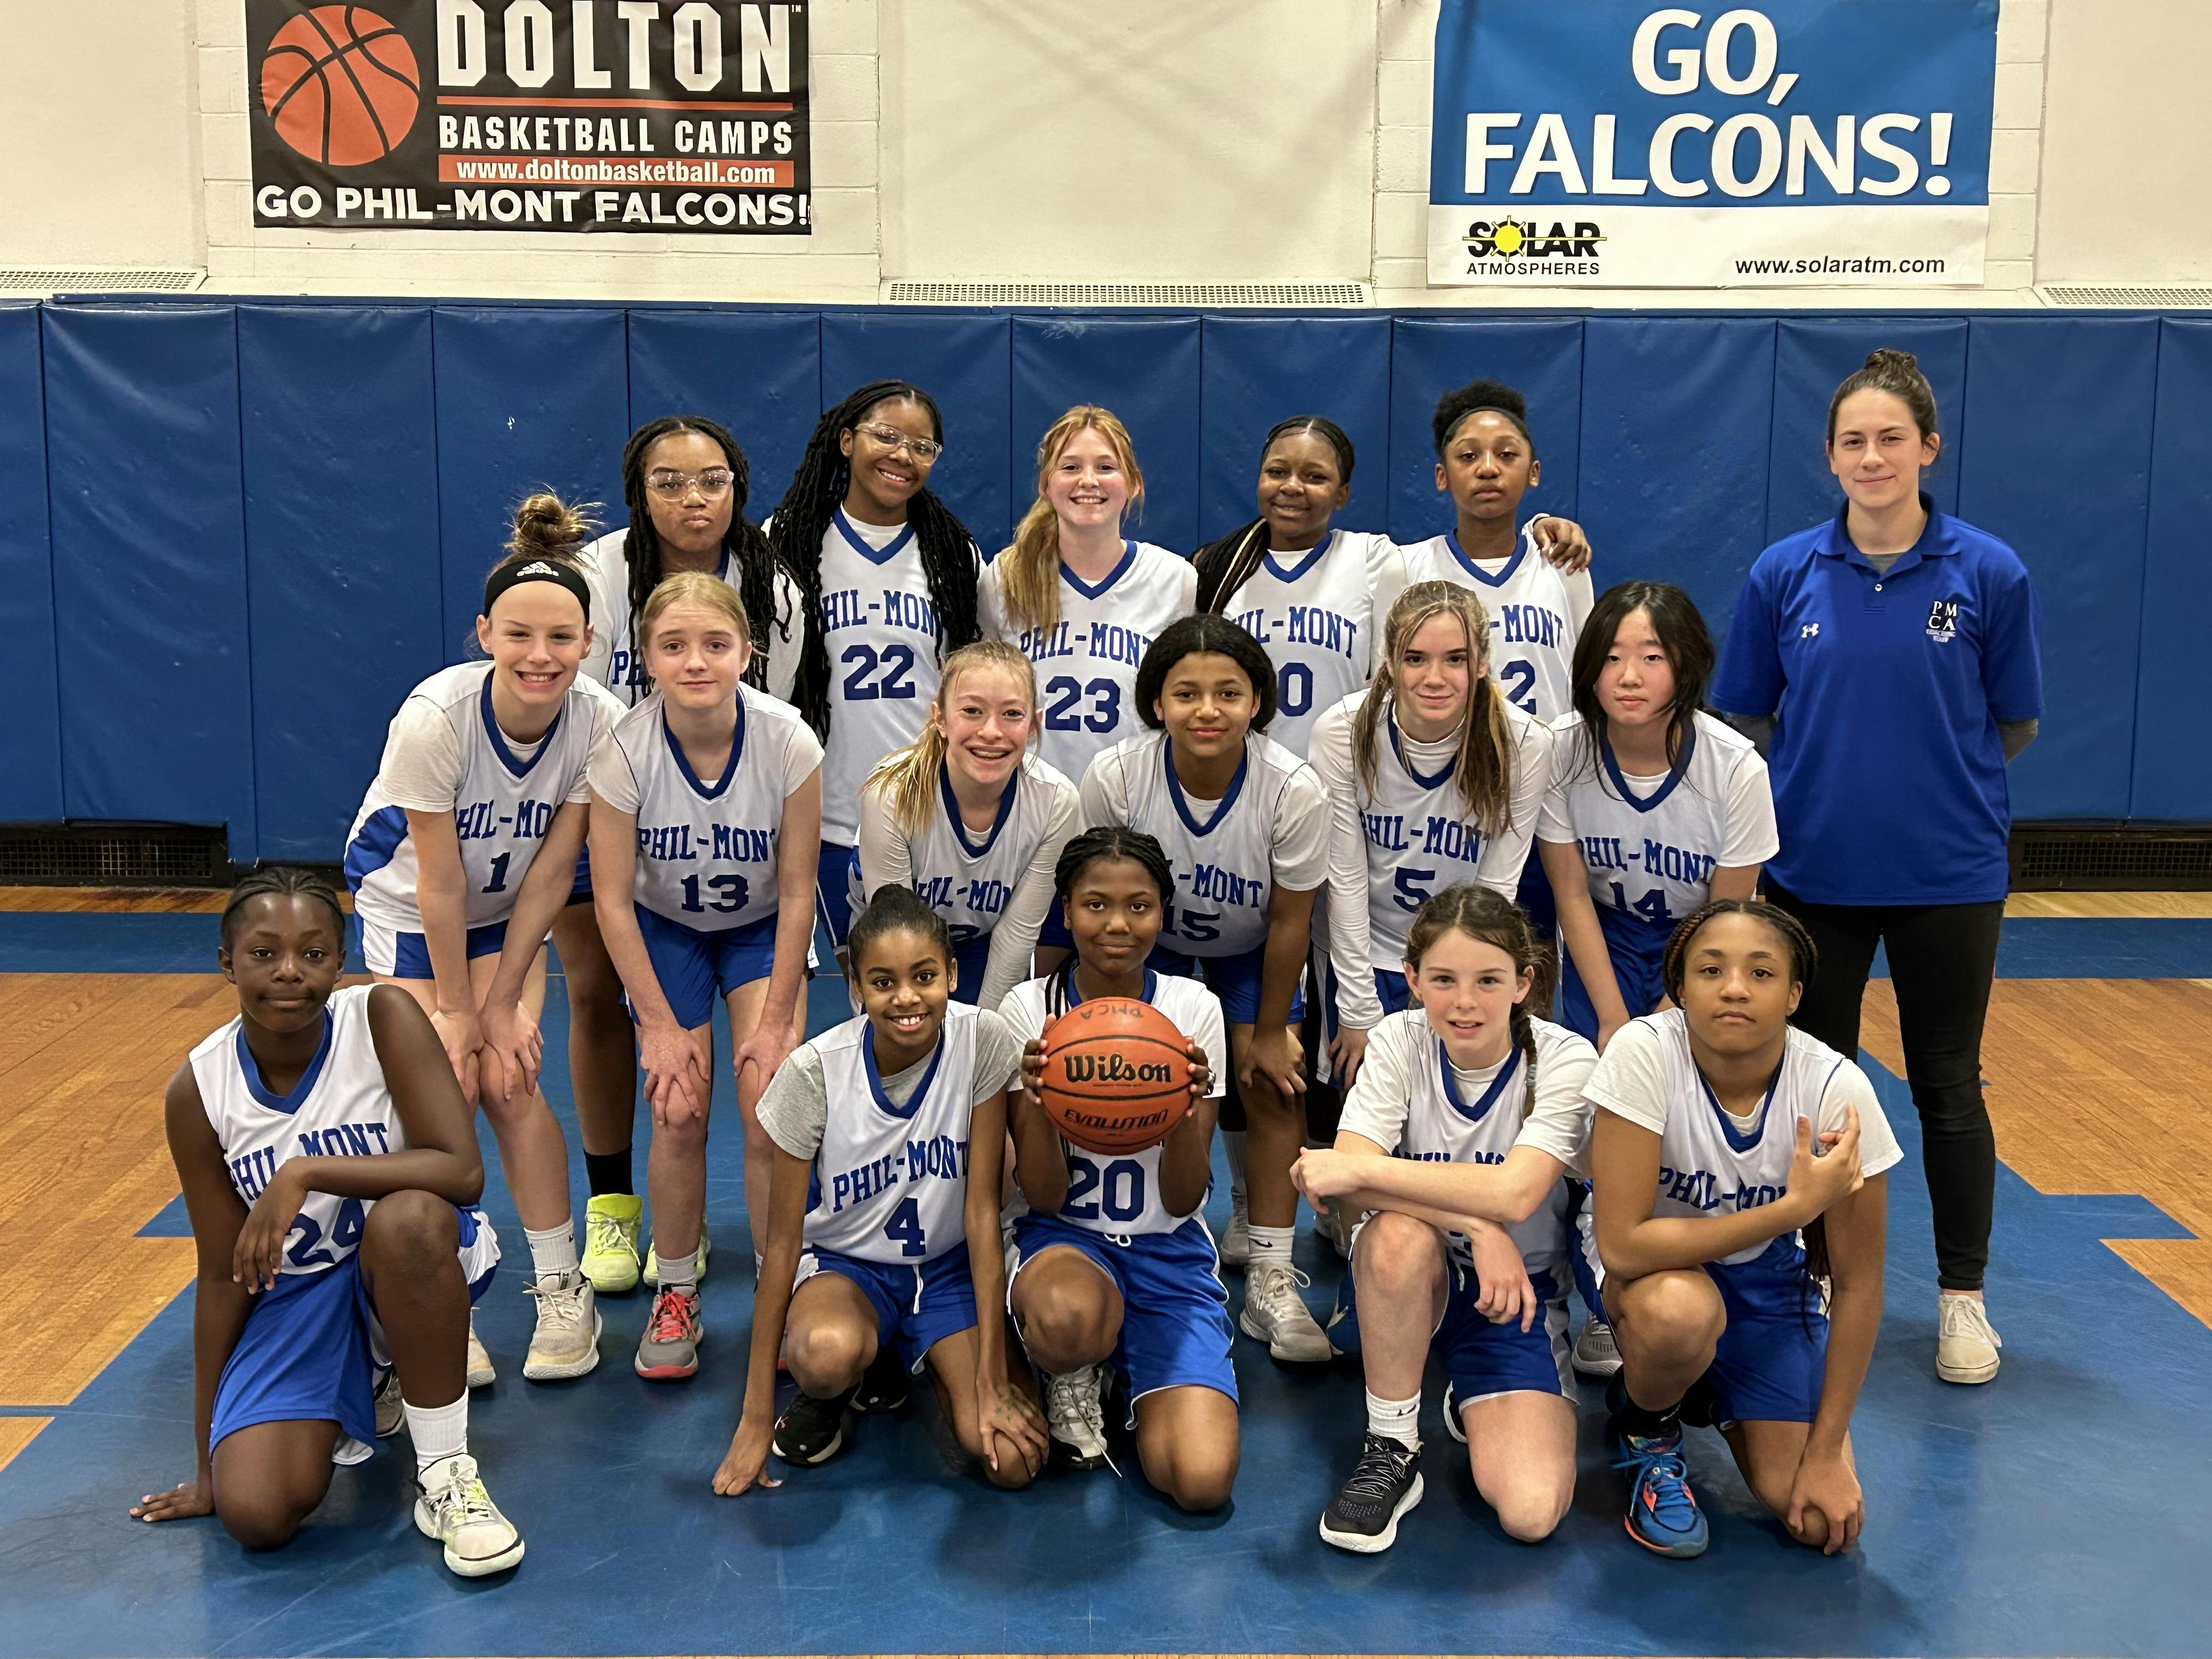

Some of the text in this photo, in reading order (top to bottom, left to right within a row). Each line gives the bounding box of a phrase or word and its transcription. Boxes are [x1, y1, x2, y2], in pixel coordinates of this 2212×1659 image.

[438, 0, 789, 92] DOLTON
[1632, 9, 1799, 105] GO,
[439, 115, 792, 154] BASKETBALL CAMPS
[1464, 112, 1953, 197] FALCONS!
[456, 159, 775, 184] www.doltonbasketball.com
[257, 185, 806, 225] GO PHIL-MONT FALCONS!
[1467, 219, 1601, 258] SOLAR
[1466, 262, 1599, 274] ATMOSPHERES
[1736, 256, 1944, 274] www.solaratm.com
[822, 590, 933, 637] HIL-MON
[1233, 606, 1357, 659] IL-MONT
[1489, 605, 1562, 648] -MONT
[841, 645, 915, 700] 22
[1045, 676, 1120, 733] 23
[456, 799, 552, 840] HIL-MO
[637, 823, 776, 862] PHIL-MON
[482, 851, 511, 893] 1
[680, 873, 749, 913] 13
[1165, 859, 1263, 908] -MONT
[1393, 866, 1436, 913] 5
[917, 877, 1012, 915] HIL-MO
[1609, 881, 1672, 922] 14
[1064, 1053, 1171, 1082] Wilson
[1064, 1108, 1169, 1129] EVOLUTION
[833, 1135, 967, 1213] PHIL-MONT
[1057, 1155, 1145, 1221] 20
[1659, 1166, 1787, 1211] PHIL-MO
[285, 1197, 366, 1267] 24
[883, 1197, 926, 1257] 4
